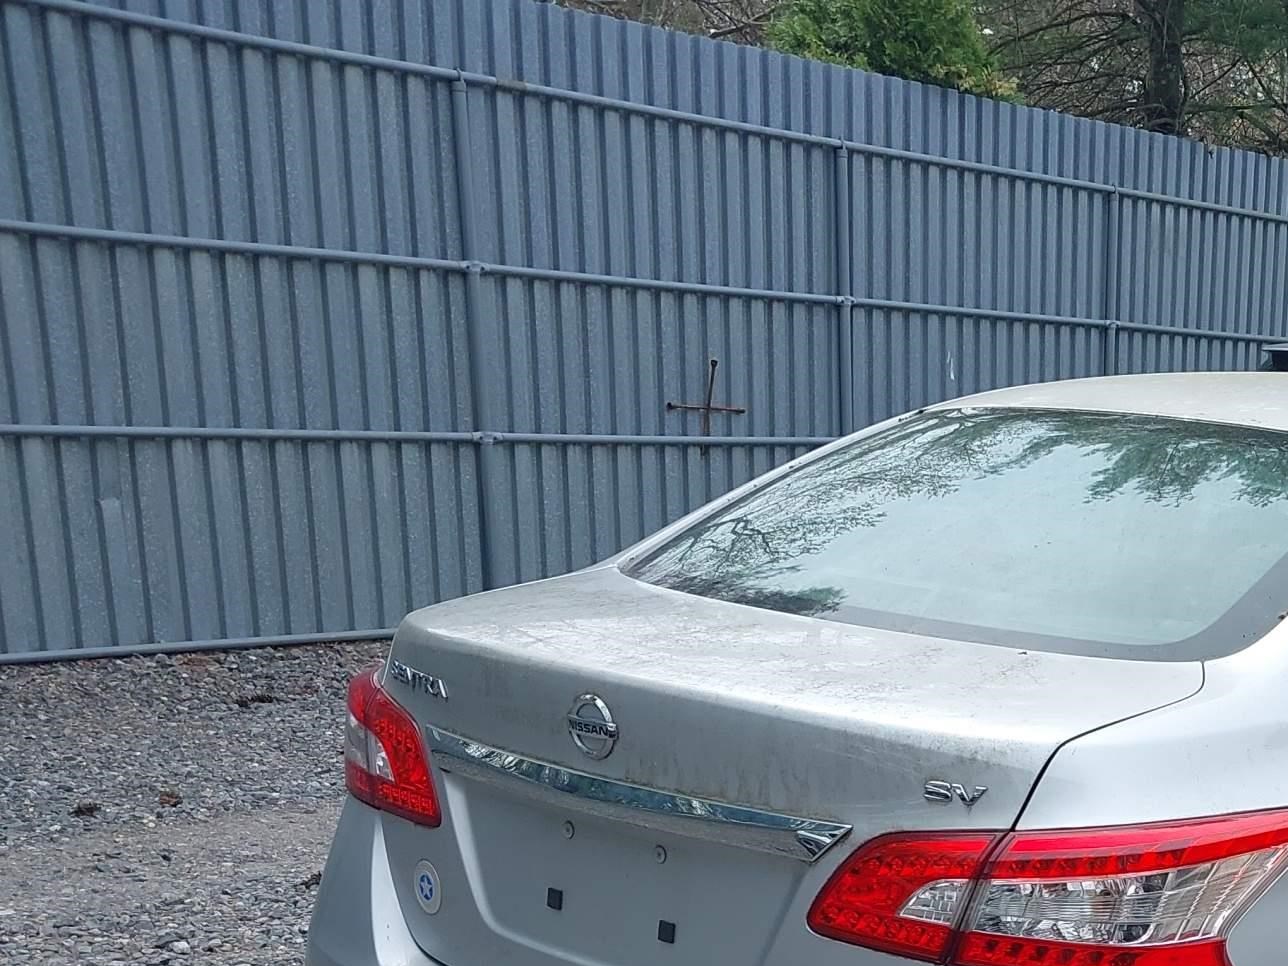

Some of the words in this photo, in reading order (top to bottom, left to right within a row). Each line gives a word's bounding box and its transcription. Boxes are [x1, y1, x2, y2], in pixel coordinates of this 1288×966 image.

[391, 659, 449, 699] SENTRA
[569, 719, 609, 736] NISSAN
[923, 780, 988, 806] SV
